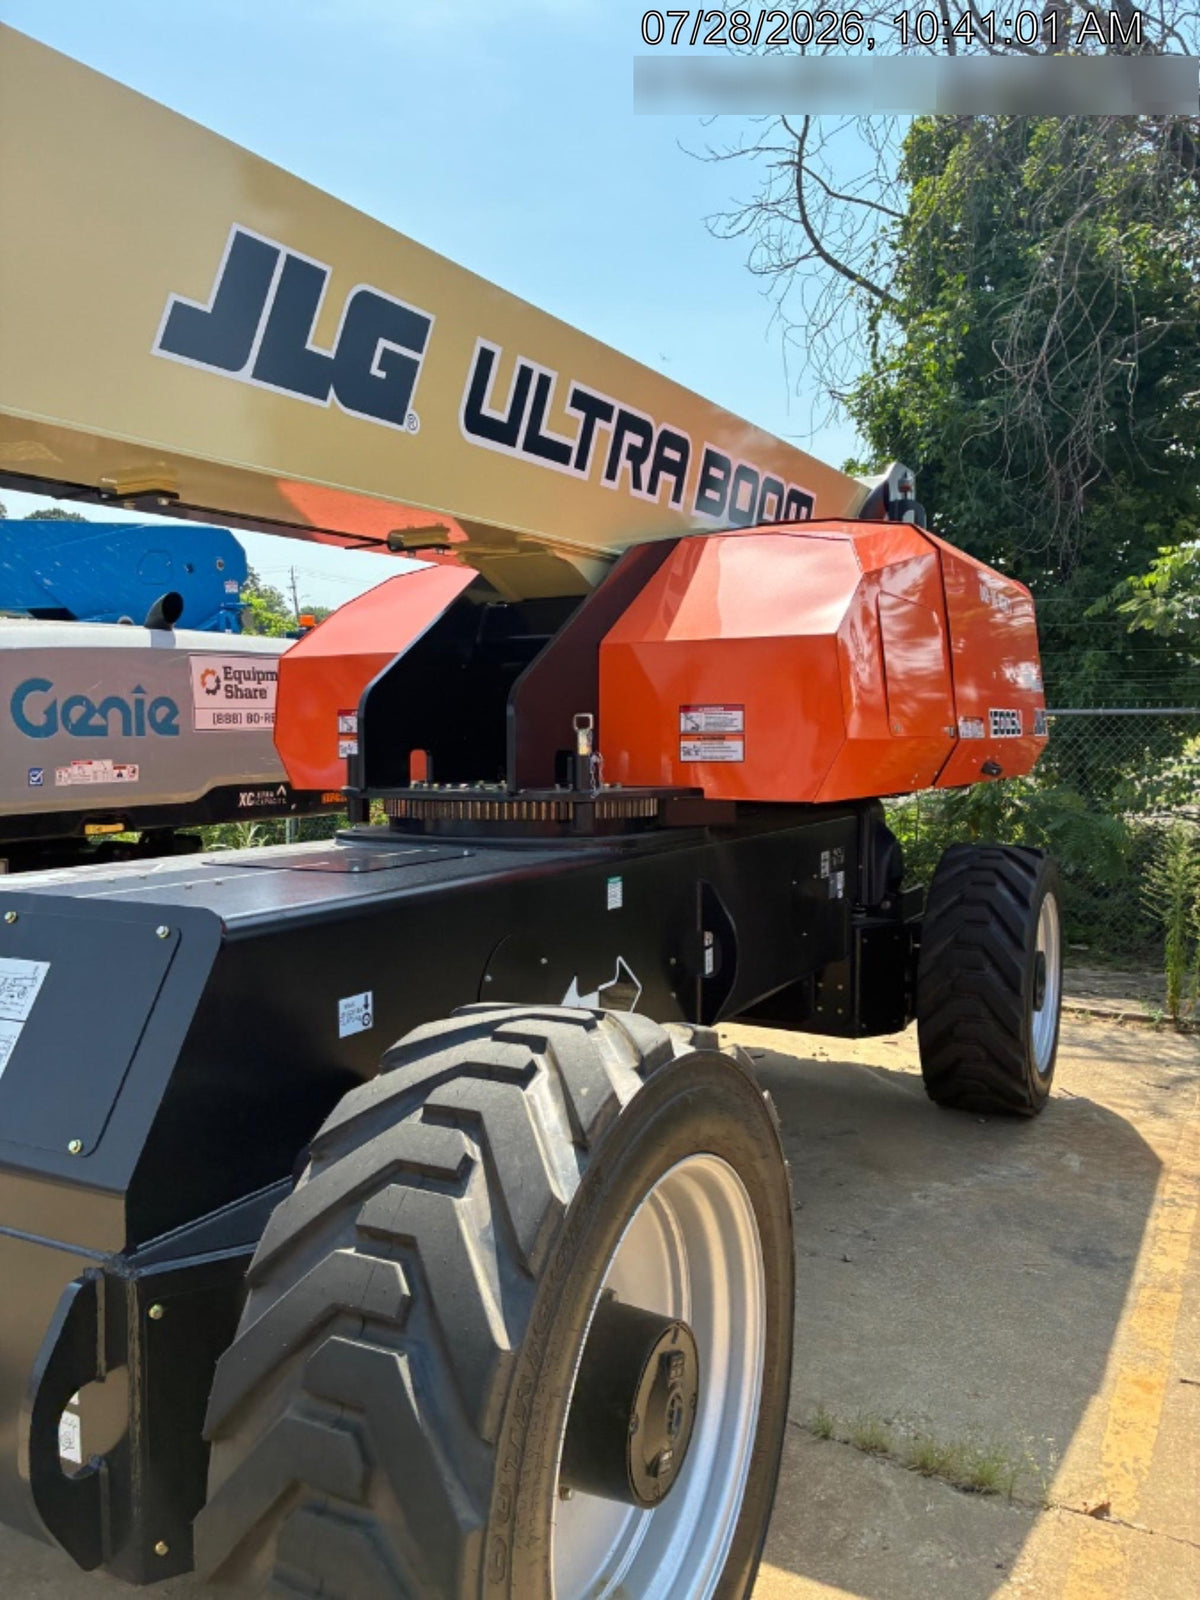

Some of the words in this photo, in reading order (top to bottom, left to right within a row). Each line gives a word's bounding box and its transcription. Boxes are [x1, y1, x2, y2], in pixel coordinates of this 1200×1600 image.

[153, 223, 435, 430] JLG
[461, 339, 691, 508] ULTRA
[692, 444, 815, 526] BOOM
[10, 678, 179, 738] Genie
[224, 684, 267, 699] Share
